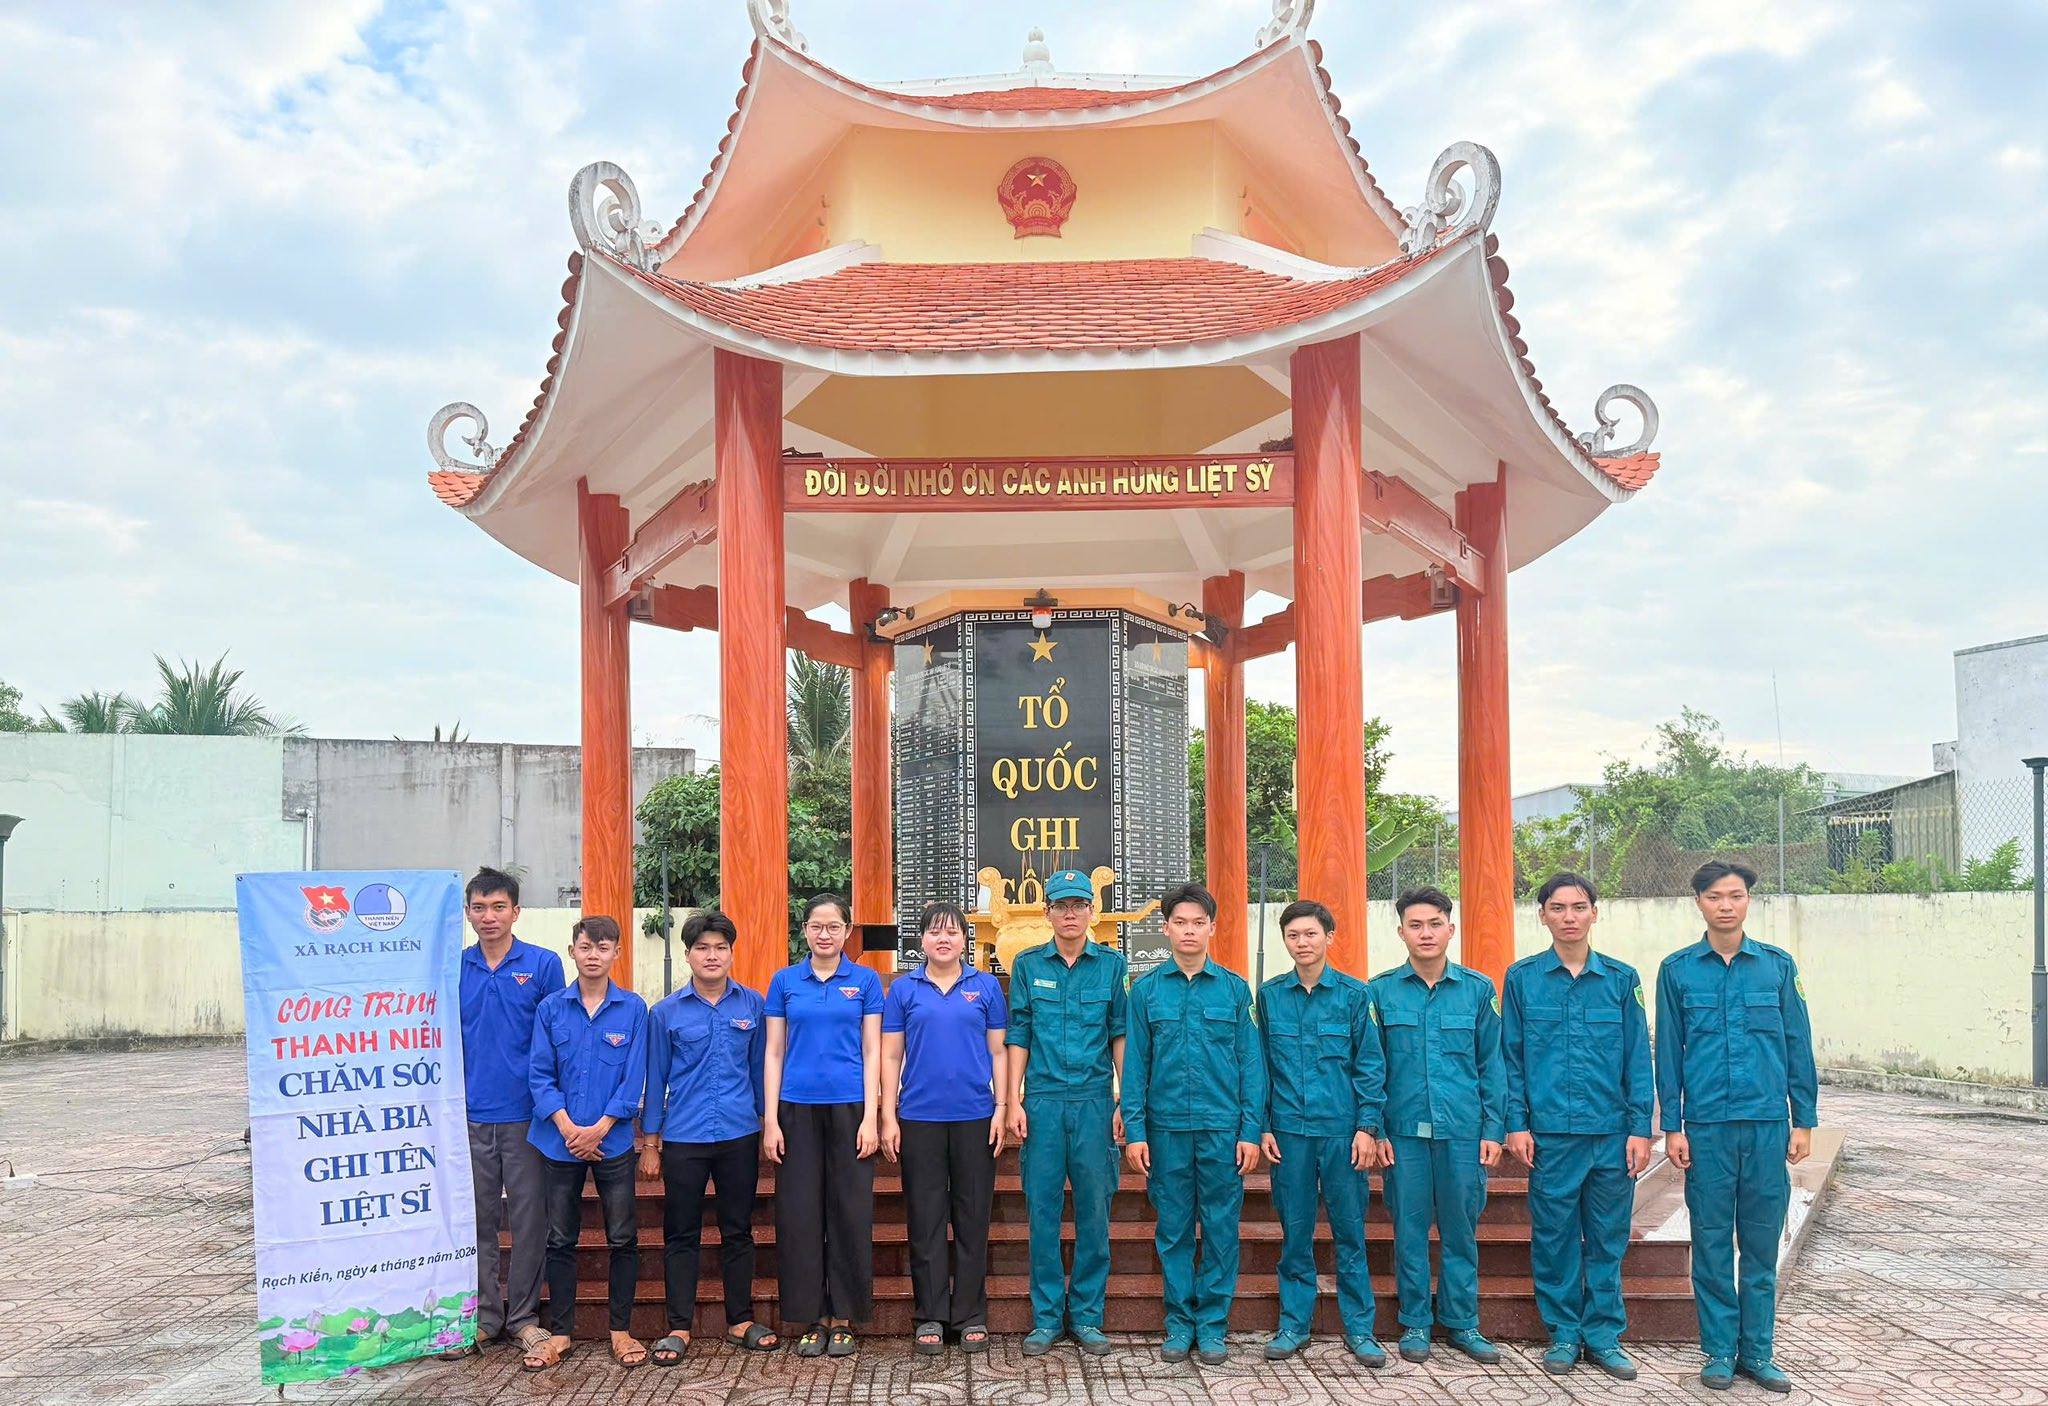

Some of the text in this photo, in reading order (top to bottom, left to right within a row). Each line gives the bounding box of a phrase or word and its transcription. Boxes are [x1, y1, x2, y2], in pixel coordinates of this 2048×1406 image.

[805, 457, 1275, 498] ĐỜI ĐỜI NHỚ ƠN CÁC ANH HÙNG LIỆT SỸ
[1018, 677, 1069, 729] TỔ
[992, 741, 1098, 799] QUỐC
[1010, 816, 1080, 852] GHI
[295, 936, 422, 957] XÃ RẠCH KIẾN
[271, 1020, 442, 1060] THANH NIÊN
[279, 1057, 441, 1097] CHĂM SÓC
[297, 1104, 432, 1140] NHÀ BIA
[304, 1142, 437, 1182] GHI TÊN
[320, 1183, 432, 1227] LIỆT SĨ
[262, 1246, 477, 1289] Rạch Kiến, ngày 4 tháng 2 năm 2026
